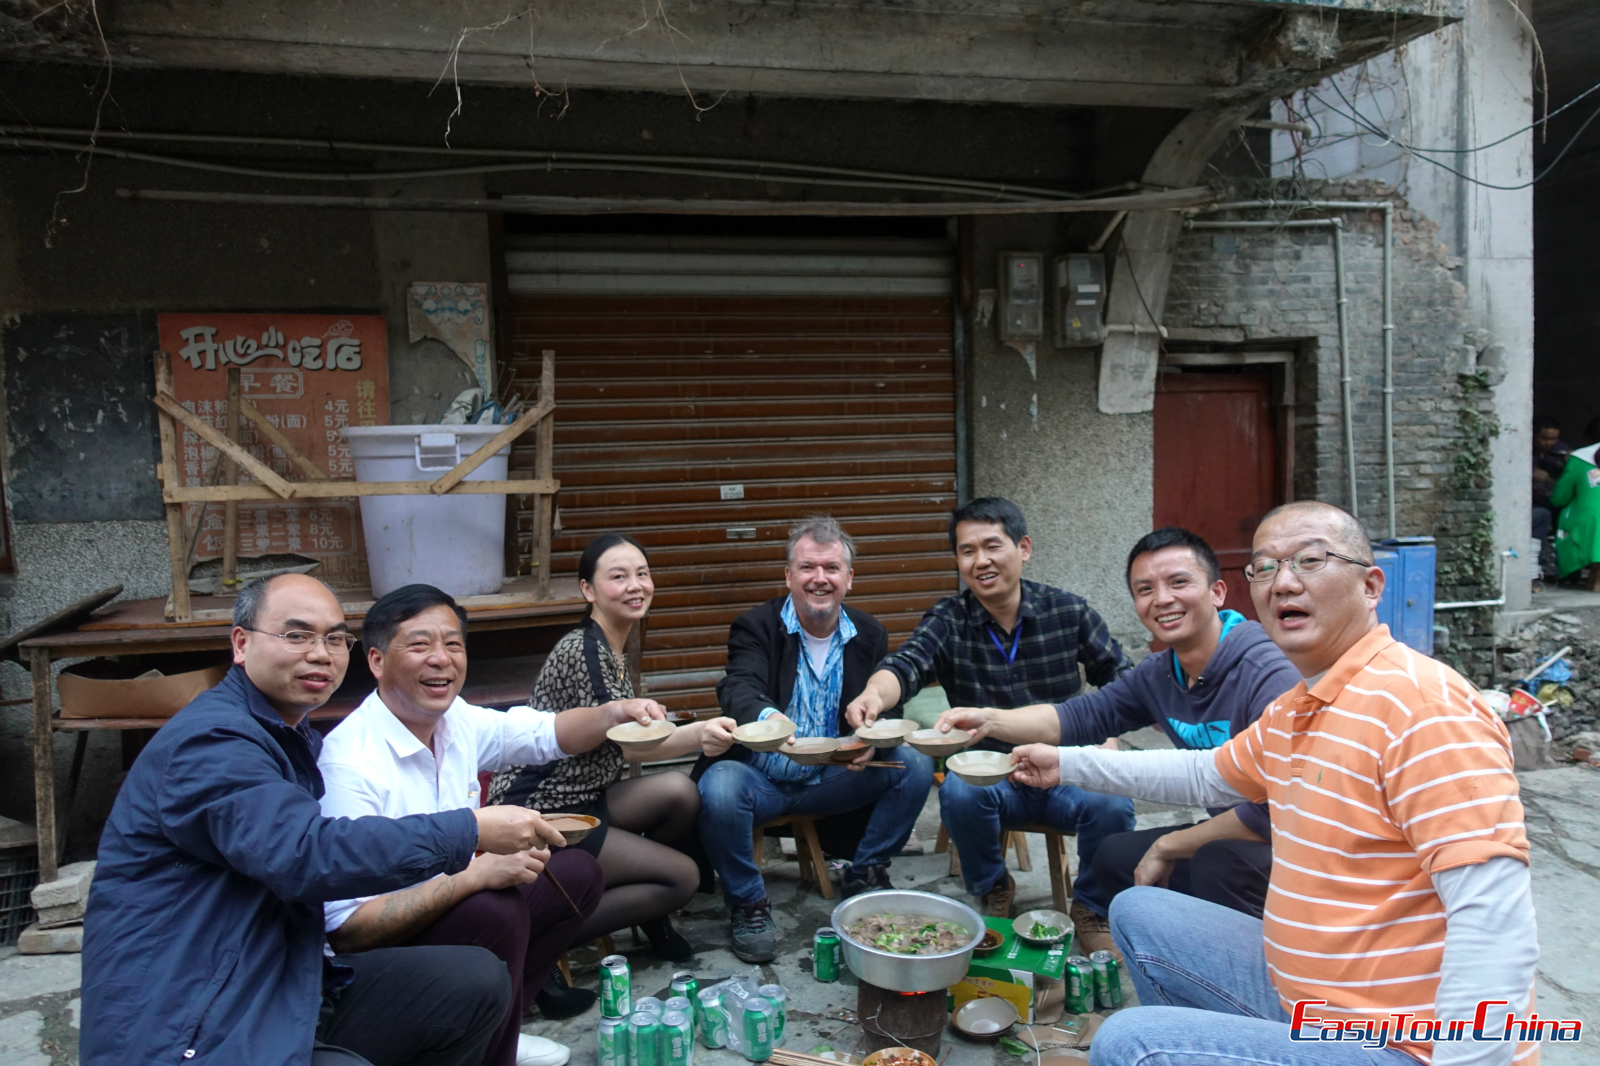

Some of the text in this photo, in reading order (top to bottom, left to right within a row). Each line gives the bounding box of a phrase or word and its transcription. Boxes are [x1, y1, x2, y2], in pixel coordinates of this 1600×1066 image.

[179, 326, 362, 370] 开心小吃店
[240, 373, 298, 393] 早餐
[325, 400, 349, 413] 4元
[324, 415, 349, 428] 5元
[328, 445, 351, 458] 5元
[329, 459, 353, 472] 5元
[309, 508, 333, 522] 6元
[309, 522, 334, 536] 8元
[312, 536, 343, 549] 10元
